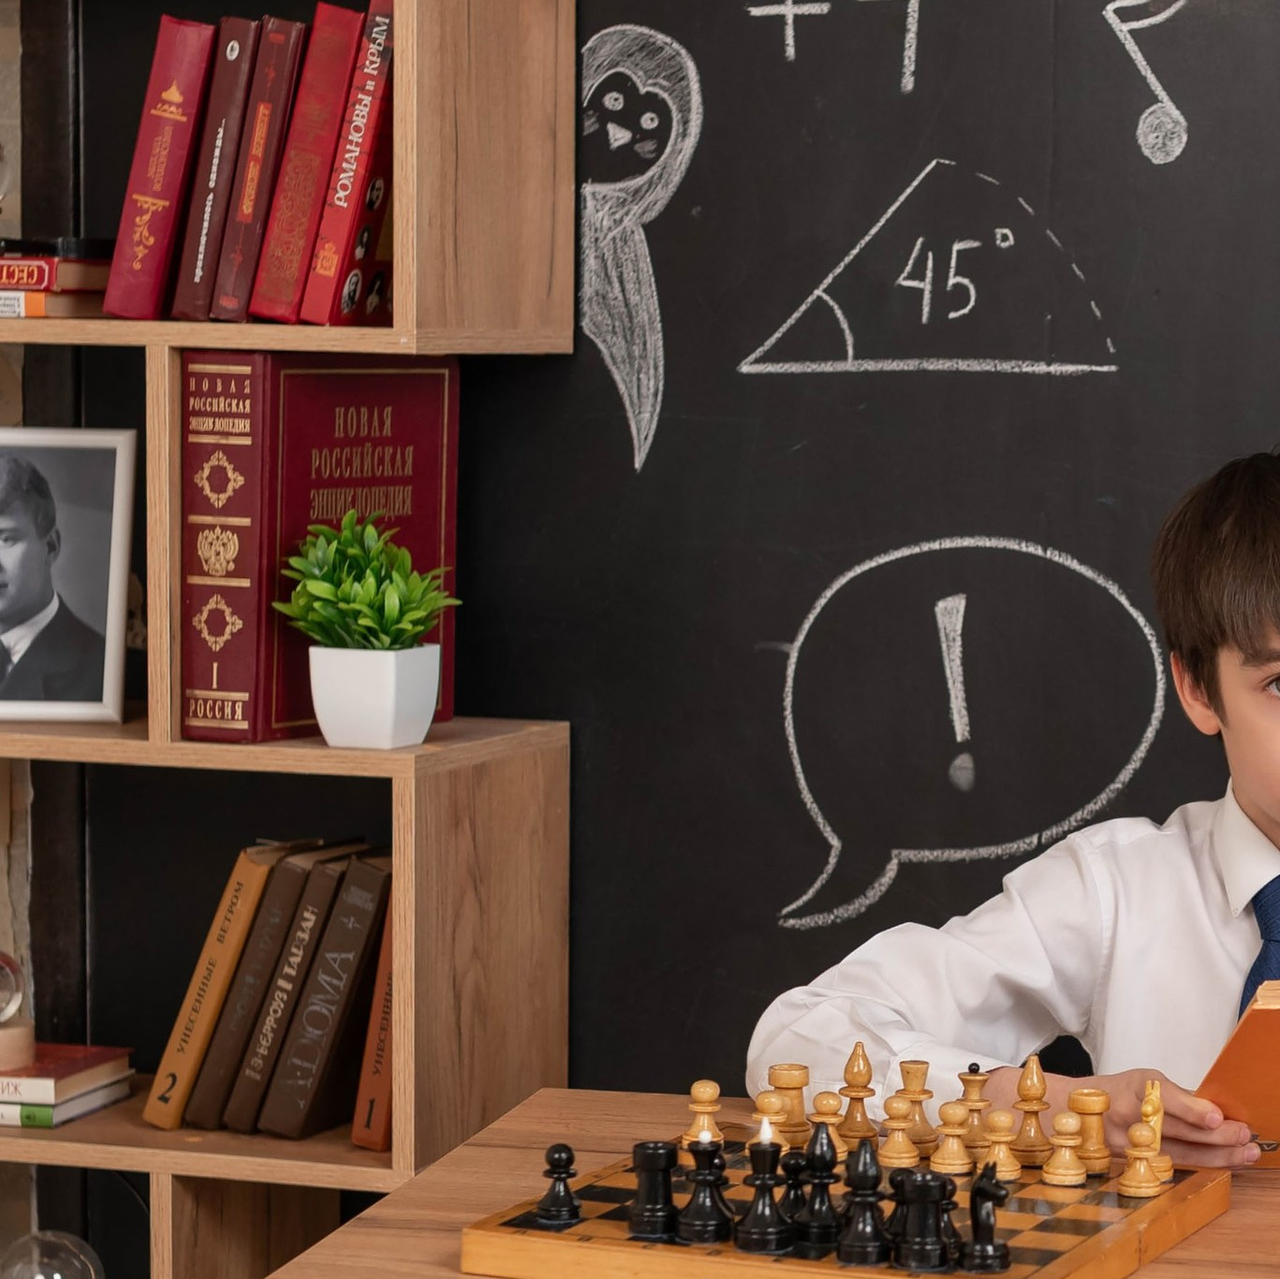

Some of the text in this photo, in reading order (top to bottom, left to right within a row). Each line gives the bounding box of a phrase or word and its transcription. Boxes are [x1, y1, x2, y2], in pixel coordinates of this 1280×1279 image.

[334, 15, 391, 209] РОМАНОВЫ и КРЫМ
[189, 377, 251, 394] НОВАЯ
[189, 396, 251, 414] РОССИЙСКАЯ
[189, 416, 251, 434] ЭНЦИКЛОПЕДИЯ
[334, 406, 393, 439] НОВАЯ
[310, 442, 414, 480] РОССИЙСКАЯ
[309, 485, 413, 525] ЭНЦИКЛОПЕДИЯ
[189, 697, 243, 721] РОССИЯ
[157, 880, 244, 1105] 2 УНЕСЕННЫЕ ВЕТРОМ
[363, 1098, 376, 1130] 1
